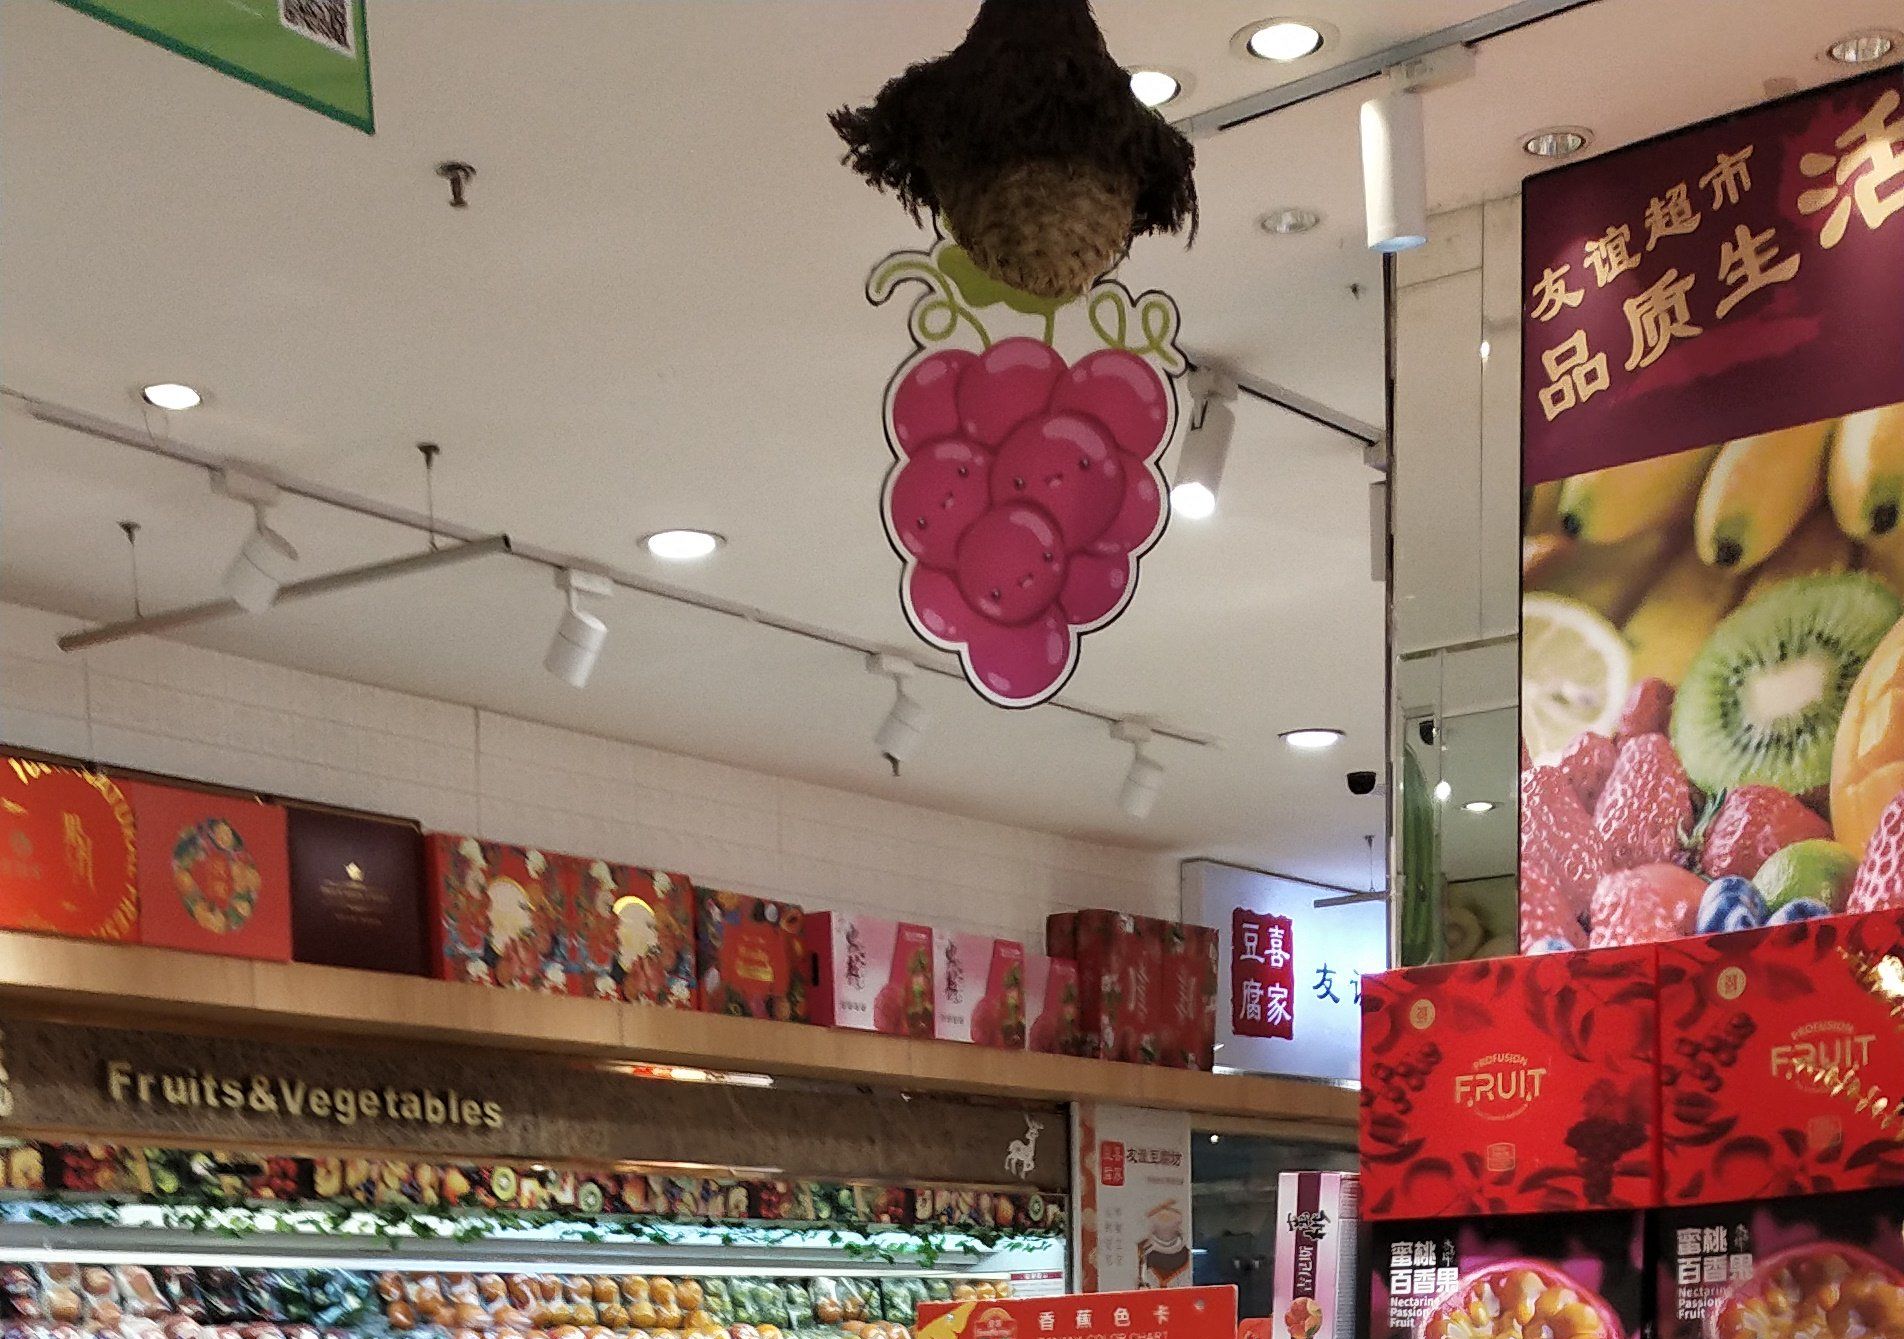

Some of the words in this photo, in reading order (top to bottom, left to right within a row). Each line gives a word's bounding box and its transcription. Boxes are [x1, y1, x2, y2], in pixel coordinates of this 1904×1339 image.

[1531, 144, 1754, 321] 友谊超市
[1538, 89, 1904, 422] 品质生活
[106, 1059, 503, 1129] Fruits&Vegetables
[1455, 1068, 1547, 1105] FRUIT
[1390, 1240, 1436, 1267] 蜜桃
[1390, 1267, 1459, 1294] 百香果
[1677, 1253, 1753, 1284] 百香果
[1390, 1307, 1430, 1317] Passion
[1678, 1298, 1725, 1308] Passion
[1678, 1308, 1706, 1320] Fruit
[1038, 1304, 1170, 1331] 香蕉色卡
[1390, 1317, 1415, 1328] Fruit
